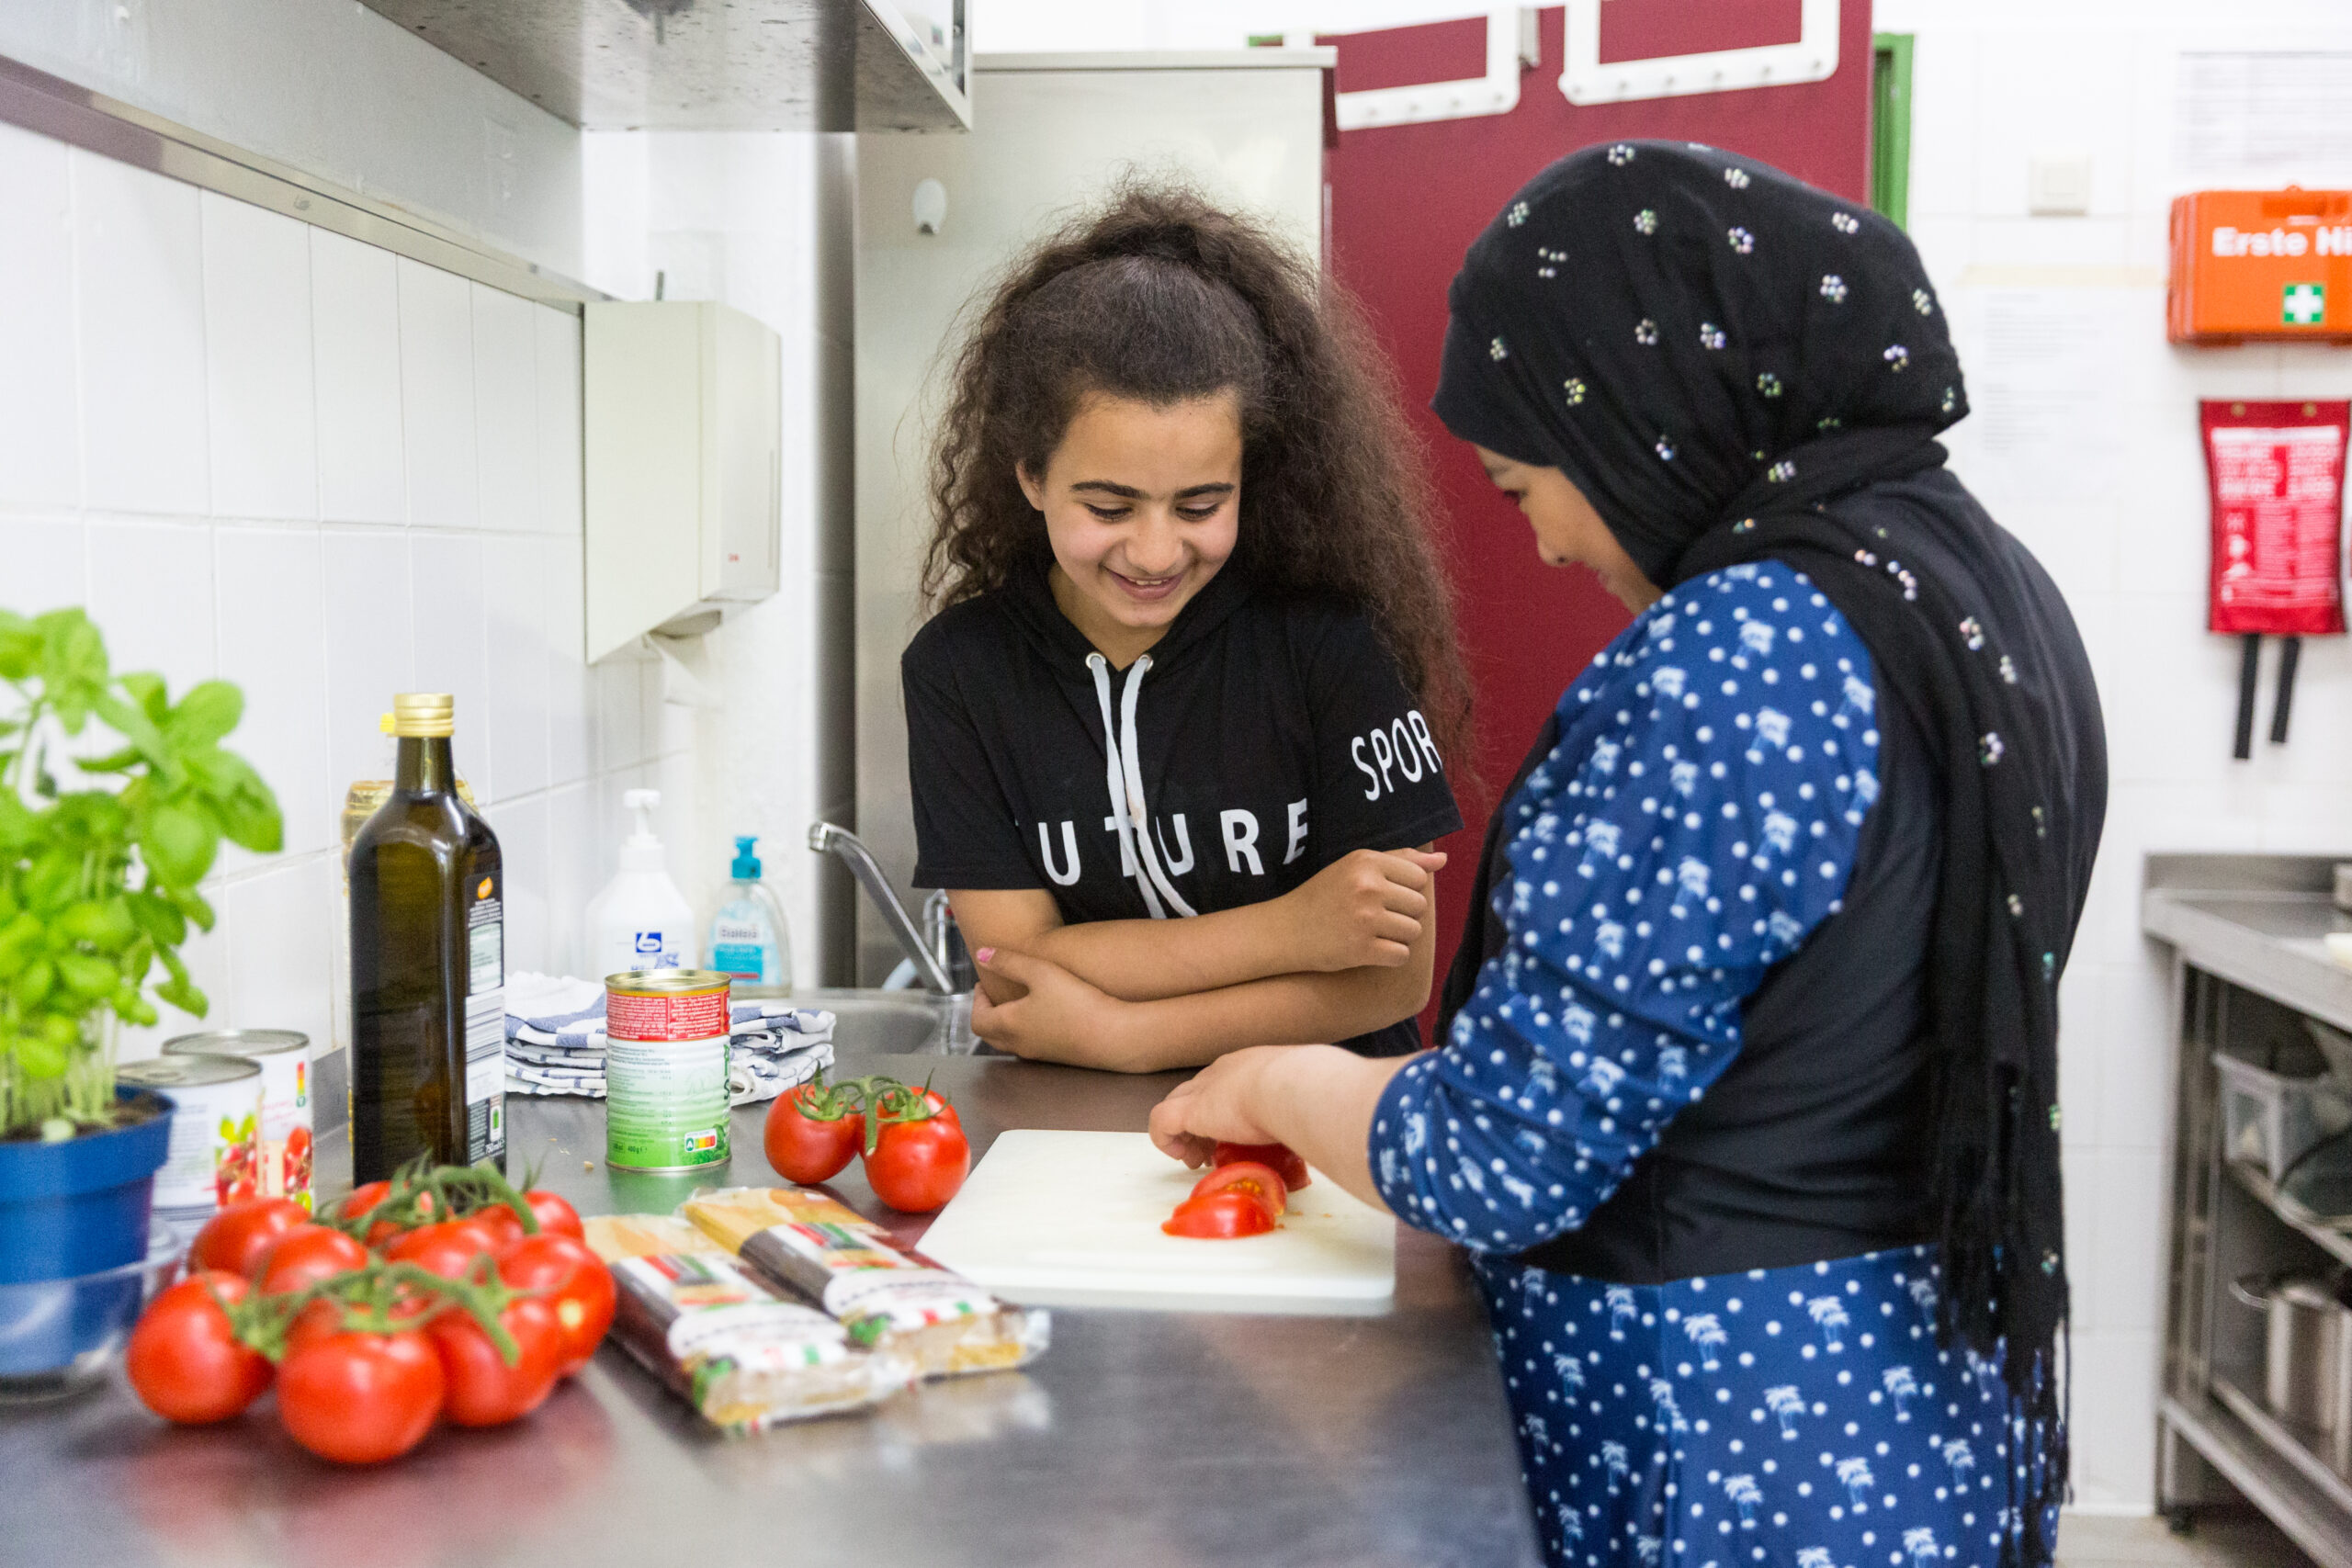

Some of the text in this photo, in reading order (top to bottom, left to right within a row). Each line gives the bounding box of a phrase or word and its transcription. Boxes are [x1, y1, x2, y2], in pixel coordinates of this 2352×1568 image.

[2211, 226, 2308, 256] Erste
[1351, 709, 1442, 801] SPOR
[1014, 797, 1308, 886] UTURE
